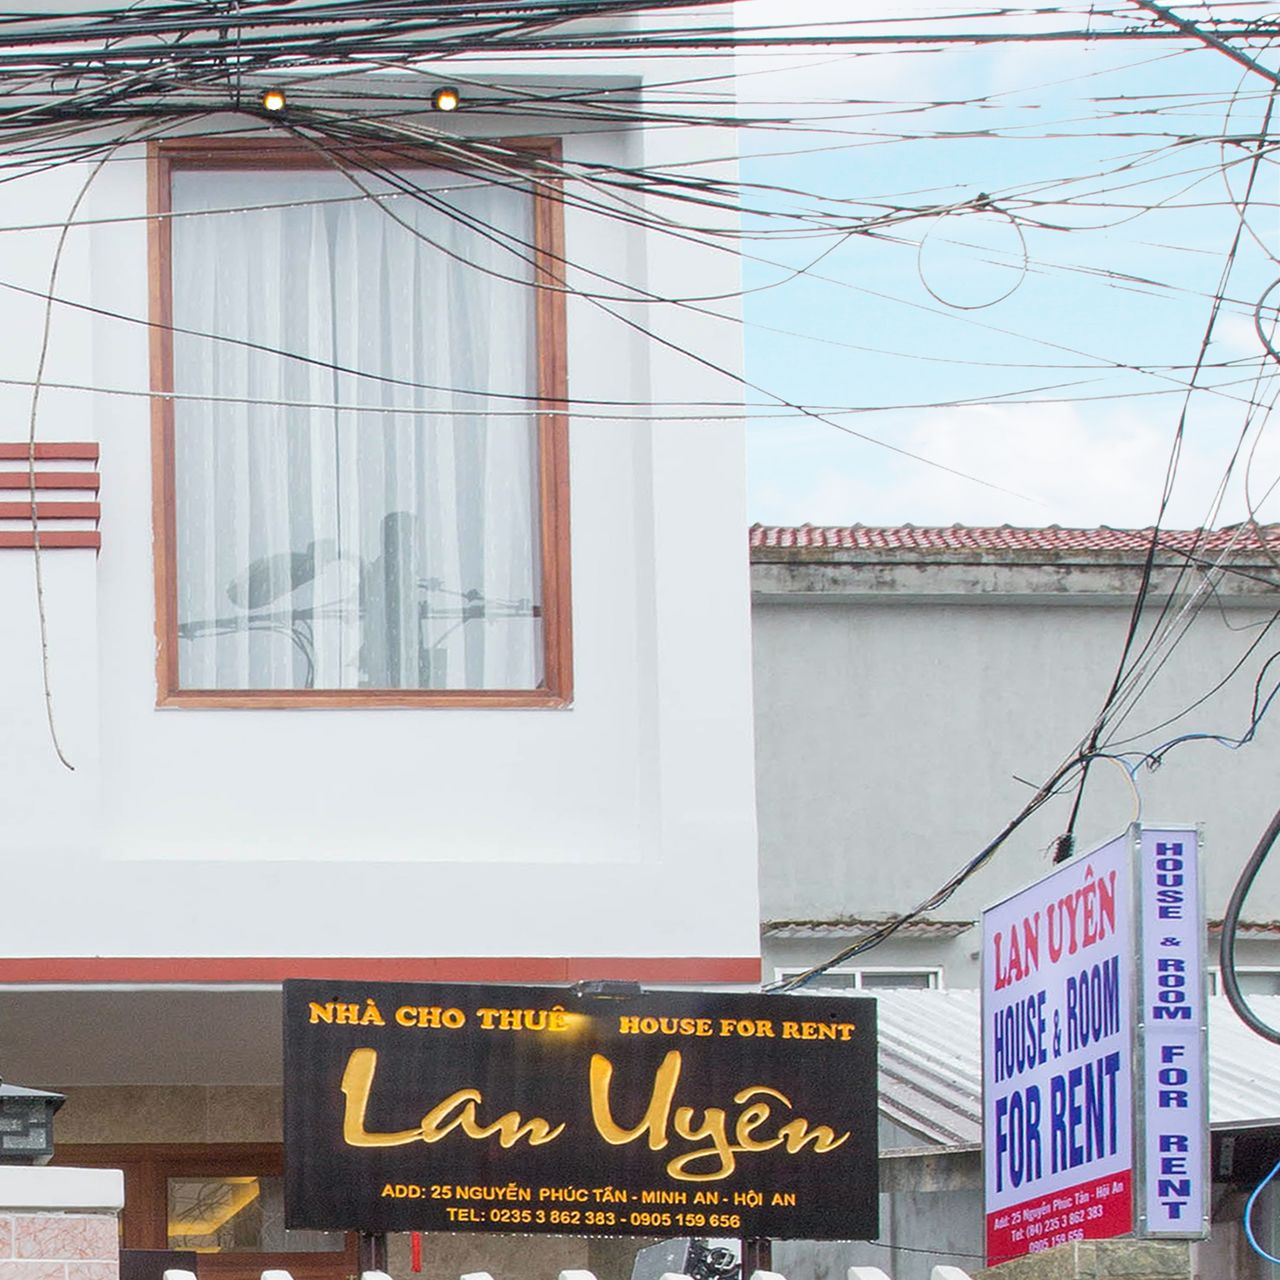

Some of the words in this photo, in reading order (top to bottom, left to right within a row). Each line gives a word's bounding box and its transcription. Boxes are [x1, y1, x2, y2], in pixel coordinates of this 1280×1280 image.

[1156, 842, 1184, 919] HOUSE
[994, 912, 1040, 991] LAN
[1046, 864, 1116, 964] UYÊN
[1160, 937, 1182, 947] &
[308, 998, 385, 1026] NHÀ
[395, 1006, 466, 1028] CHO
[477, 1005, 570, 1031] THUÊ
[994, 989, 1047, 1083] HOUSE
[1053, 1008, 1062, 1059] &
[1066, 955, 1120, 1052] ROOM
[1153, 958, 1192, 1020] ROOM
[619, 1016, 713, 1036] HOUSE
[719, 1019, 774, 1037] FOR
[782, 1021, 855, 1041] RENT
[1158, 1046, 1188, 1108] FOR
[341, 1047, 566, 1149] Lan
[589, 1049, 851, 1181] Uyên
[995, 1085, 1042, 1193] FOR
[1051, 1051, 1120, 1174] RENT
[381, 1184, 426, 1199] ADD:
[431, 1185, 452, 1199] 25
[456, 1182, 531, 1201] NGUYỄN
[539, 1186, 588, 1202] PHÚC
[641, 1190, 687, 1205] MINH
[693, 1191, 718, 1205] AN
[734, 1190, 763, 1208] HỘI
[771, 1193, 796, 1206] AN
[1011, 1210, 1022, 1224] 25
[1112, 1181, 1124, 1194] An
[1158, 1135, 1191, 1220] RENT
[446, 1207, 485, 1221] TEL:
[489, 1209, 532, 1223] 0235
[535, 1210, 545, 1224] 3
[550, 1210, 580, 1224] 862
[585, 1211, 616, 1225] 383
[630, 1212, 671, 1227] 0905
[675, 1213, 706, 1227] 159
[709, 1214, 741, 1228] 656
[1044, 1216, 1060, 1232] 235
[1061, 1214, 1068, 1227] 3
[1069, 1209, 1085, 1225] 862
[1087, 1204, 1104, 1220] 383
